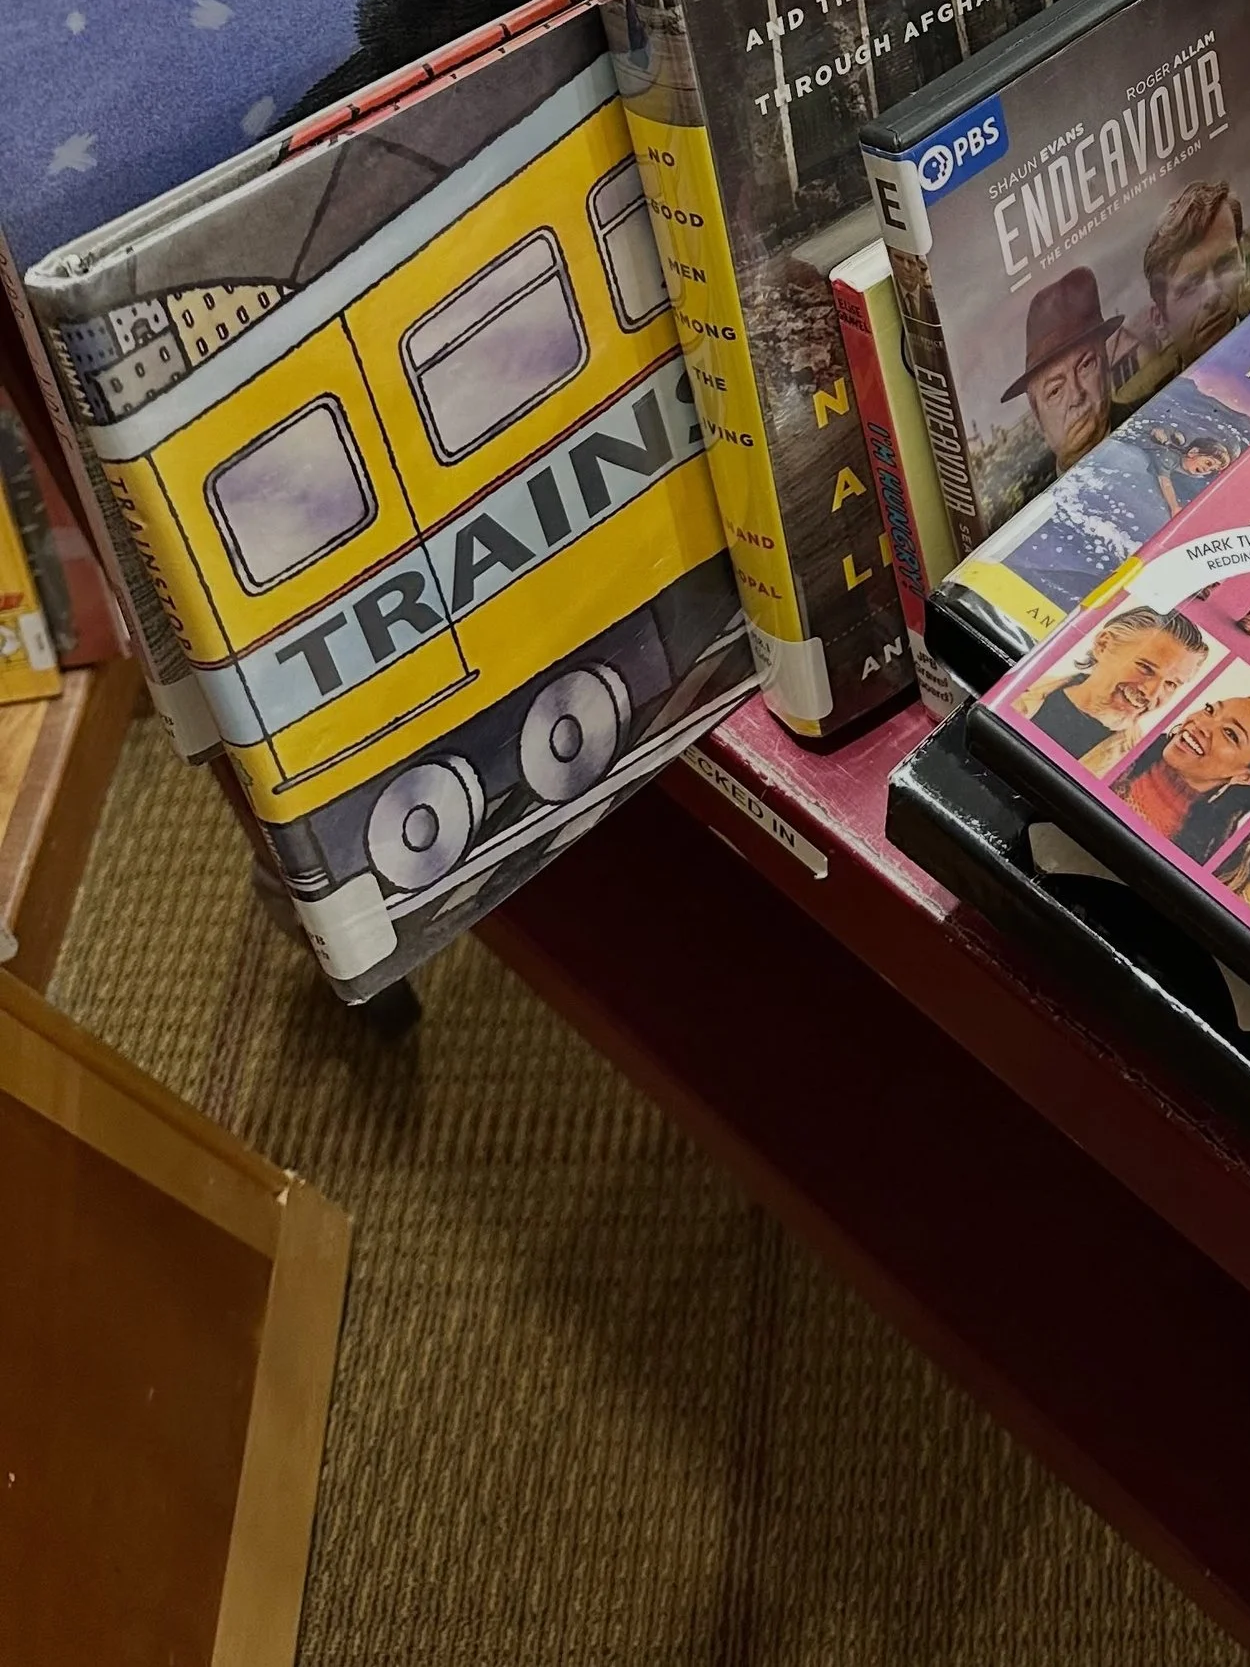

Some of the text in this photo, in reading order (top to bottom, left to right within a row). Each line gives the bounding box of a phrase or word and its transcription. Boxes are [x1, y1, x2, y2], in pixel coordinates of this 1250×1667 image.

[745, 6, 806, 52] AND
[753, 32, 892, 117] THROUGH
[1126, 30, 1216, 102] ROGER ALLAM
[648, 144, 676, 168] NO
[954, 115, 1000, 168] PBS
[988, 122, 1086, 200] SHAUN EVANS
[993, 49, 1227, 278] ENDEAVOUR
[650, 199, 705, 229] GOOD
[875, 177, 907, 231] E
[1040, 140, 1202, 271] THE COMPLETE NINTH SEASON
[668, 258, 707, 285] MEN
[50, 328, 94, 418] LEHMAN
[813, 376, 850, 429] N
[703, 417, 755, 447] IVING
[868, 420, 898, 475] I'M
[914, 363, 977, 523] ENDEAVOUR
[958, 521, 974, 557] SEA
[109, 476, 193, 655] TRAINSTOP
[1185, 536, 1233, 561] MARK
[737, 568, 783, 600] OPAL
[1025, 603, 1055, 629] AN
[683, 748, 795, 848] ECKED IN
